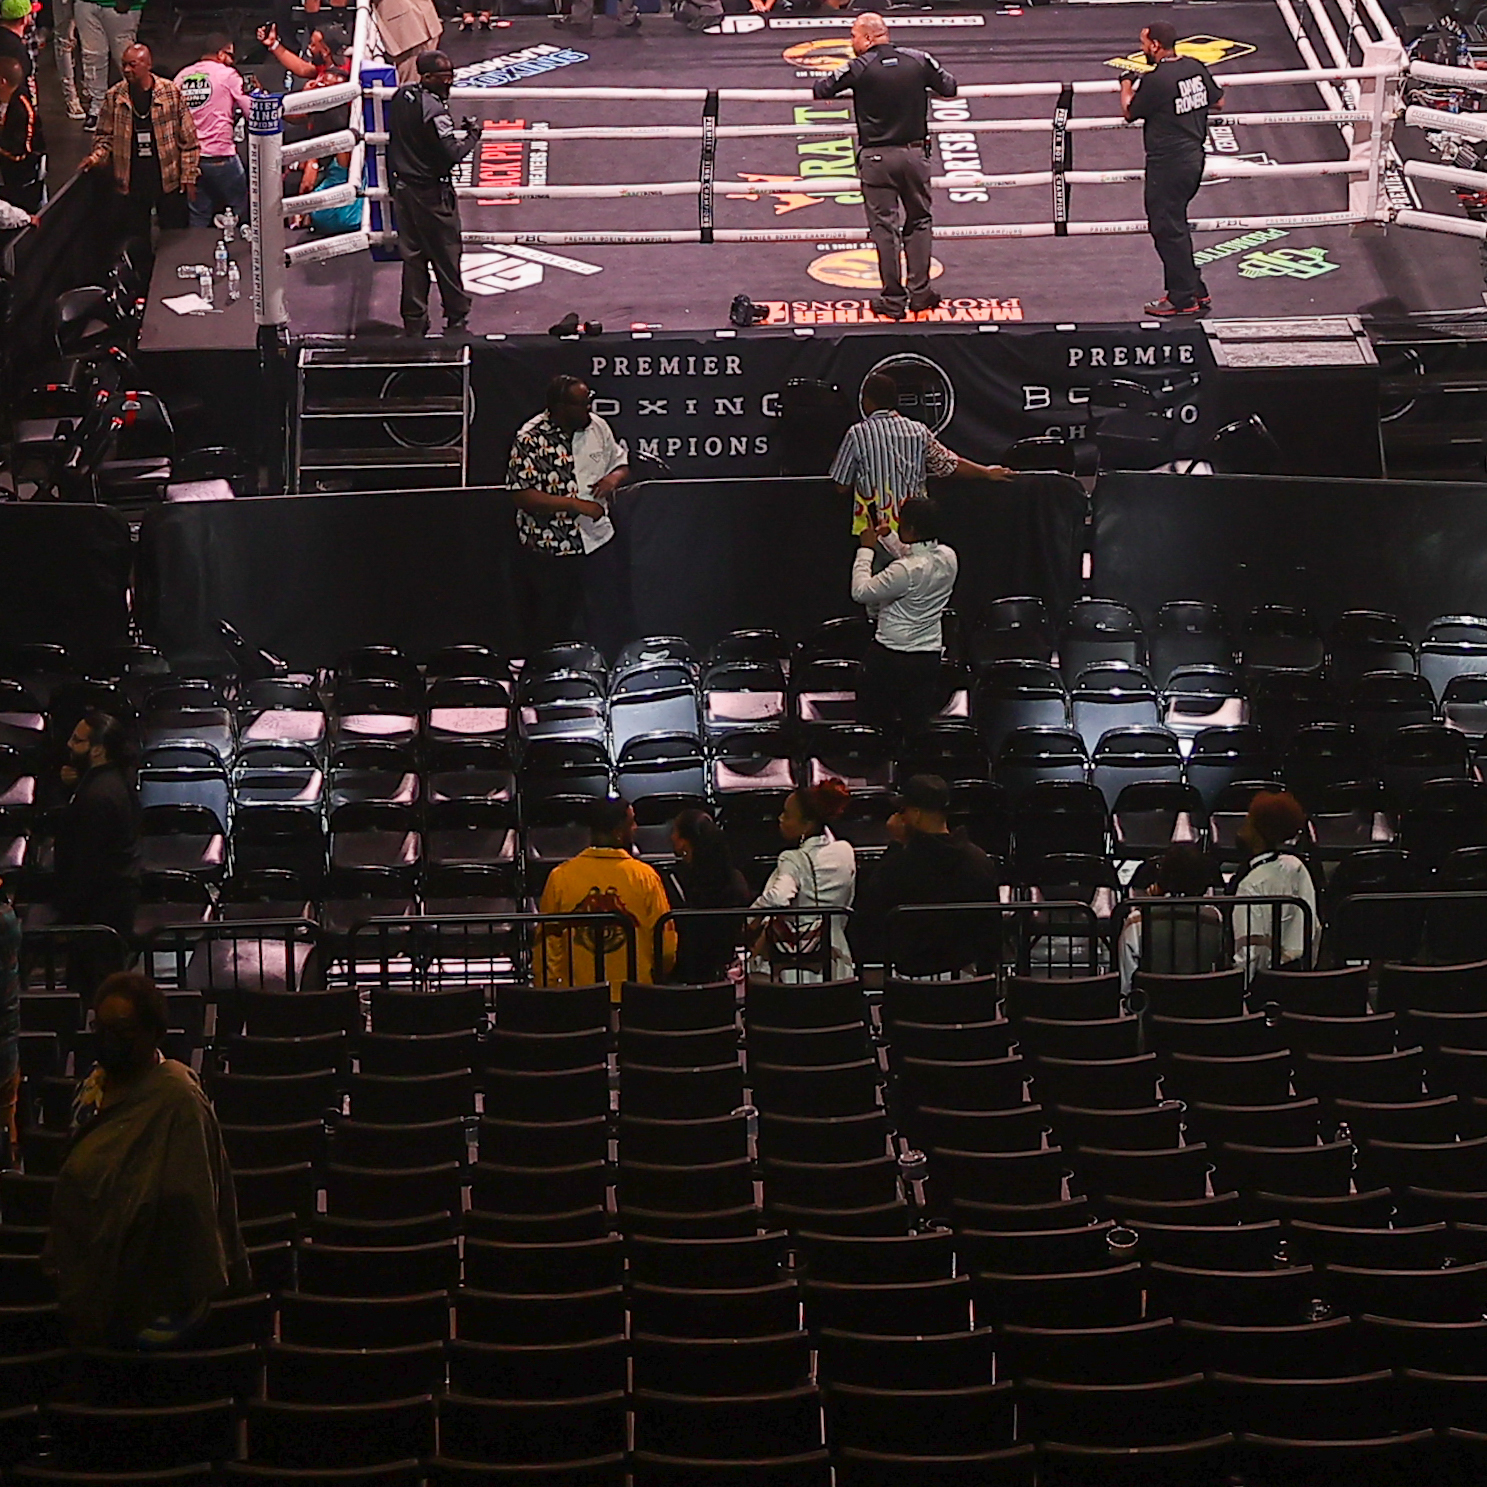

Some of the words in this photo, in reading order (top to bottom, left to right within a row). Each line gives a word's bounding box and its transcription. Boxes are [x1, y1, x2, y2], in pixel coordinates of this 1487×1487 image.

[591, 355, 745, 377] PREMIER
[1068, 344, 1195, 368] PREMIE
[617, 435, 769, 458] AMPIONS
